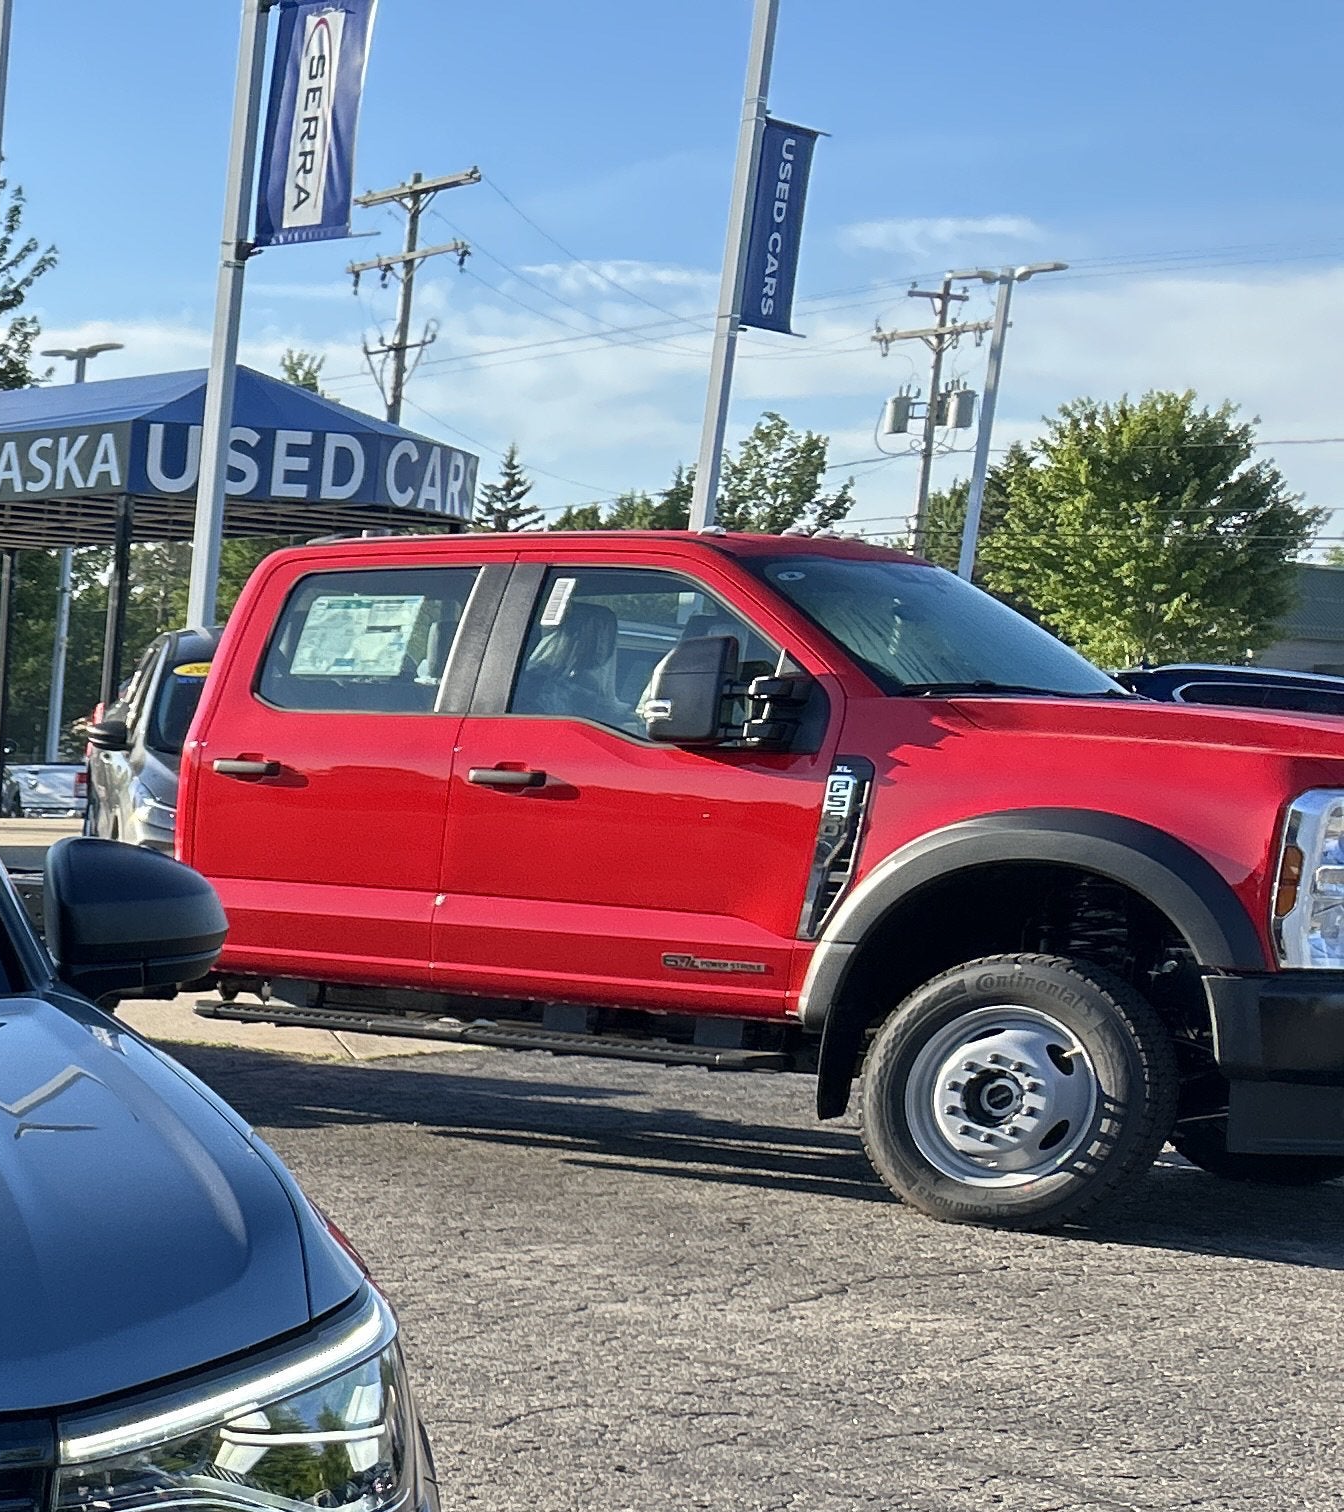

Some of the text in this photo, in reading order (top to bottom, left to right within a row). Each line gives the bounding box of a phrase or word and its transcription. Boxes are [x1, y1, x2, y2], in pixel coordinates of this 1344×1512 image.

[293, 54, 326, 211] SERRA
[762, 138, 796, 316] USED CARS
[145, 424, 365, 500] USED
[835, 765, 852, 773] XL
[975, 972, 1080, 1009] Continental
